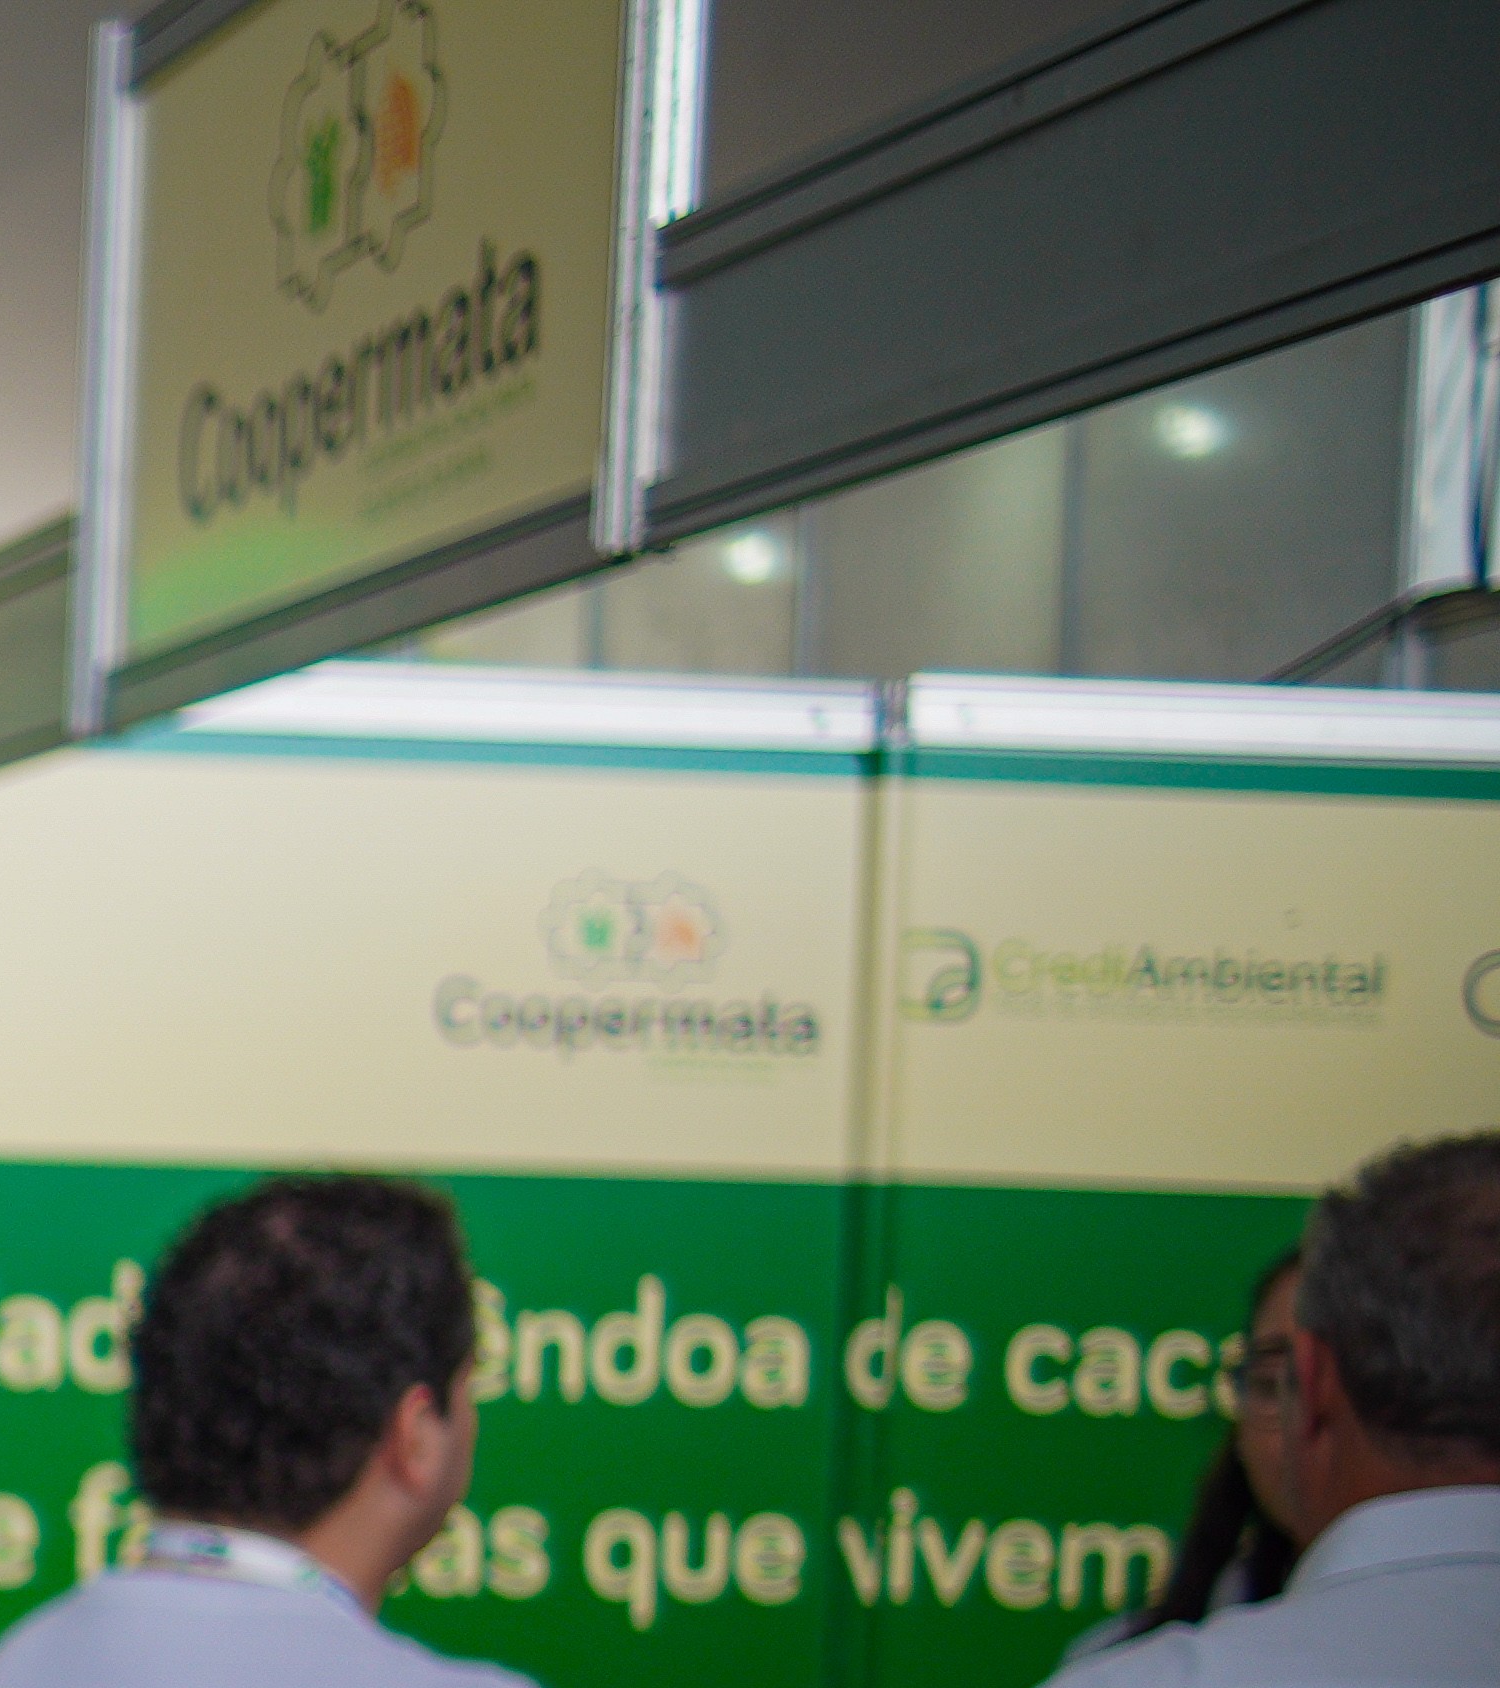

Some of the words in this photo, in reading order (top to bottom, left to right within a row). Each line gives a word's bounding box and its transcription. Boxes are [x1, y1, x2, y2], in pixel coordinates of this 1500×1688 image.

[177, 240, 543, 528] Coopermata
[431, 974, 821, 1062] Coopermata
[843, 1283, 973, 1413] de
[581, 1506, 807, 1634] que
[837, 1484, 1178, 1613] vivem
